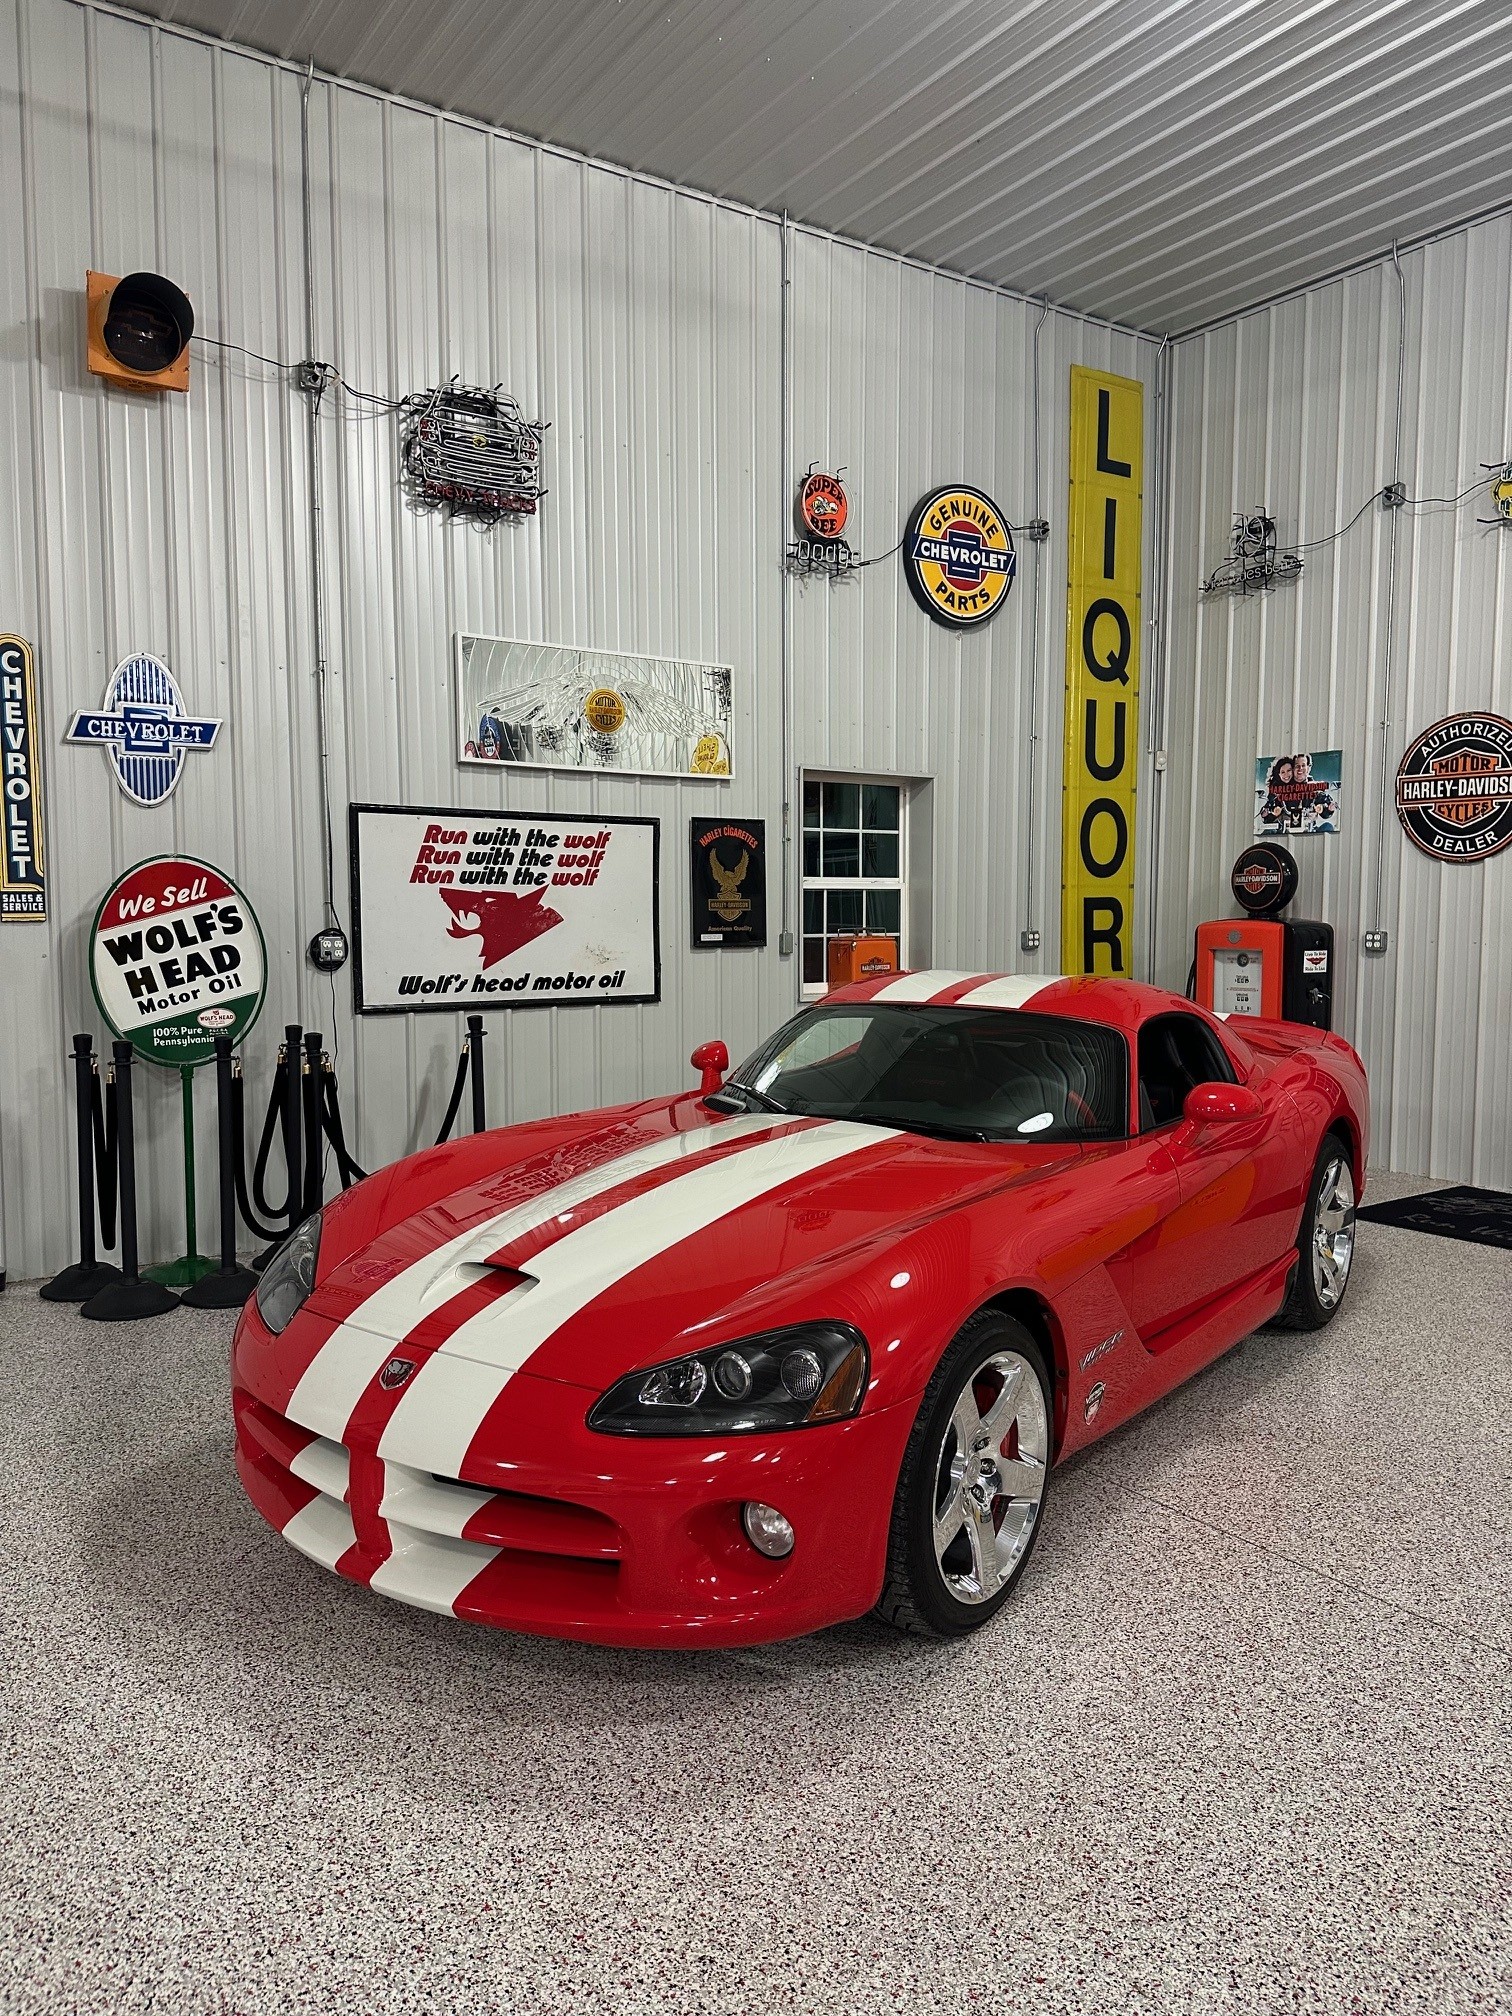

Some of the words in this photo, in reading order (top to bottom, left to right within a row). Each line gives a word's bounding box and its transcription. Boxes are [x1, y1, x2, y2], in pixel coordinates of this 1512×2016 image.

[805, 478, 844, 506] SUPER
[810, 514, 838, 533] BEE
[929, 499, 999, 539] GENUINE
[798, 540, 860, 569] Dodge
[920, 541, 1008, 570] CHEVROLET
[935, 581, 991, 611] PARTS
[1079, 389, 1132, 975] LIQUOR
[87, 719, 204, 742] CHEVROLET
[2, 650, 31, 878] CHEVROLET
[1437, 753, 1492, 774] MOTOR
[1268, 782, 1329, 794] HARLEY-DAVIDSON
[1403, 775, 1512, 800] HARLEY-DAVIDS
[1437, 800, 1490, 822] CYCLES
[423, 824, 468, 845] Run
[472, 826, 521, 847] with
[525, 828, 560, 848] the
[563, 831, 612, 849] wolf
[699, 827, 722, 847] HARLEY
[723, 825, 758, 849] CIGARETTES
[1432, 830, 1499, 853] DEALER
[416, 845, 462, 865] Run
[465, 846, 515, 866] with
[518, 848, 554, 867] the
[557, 851, 606, 868] wolf
[409, 865, 455, 884] Run
[458, 866, 509, 885] with
[512, 867, 548, 886] the
[551, 869, 599, 886] wolf
[2, 902, 44, 911] SERVICE
[36, 894, 43, 902] &
[119, 895, 156, 920] We
[160, 876, 208, 908] Sell
[102, 903, 243, 966] WOLF'S
[124, 944, 241, 999] HEAD
[399, 974, 468, 995] Wolf's
[471, 974, 530, 993] head
[532, 972, 595, 991] motor
[598, 970, 626, 988] oil
[137, 988, 201, 1015] Motor
[208, 973, 242, 994] Oil
[153, 1027, 180, 1038] 100%
[180, 1026, 203, 1036] Pure
[153, 1035, 215, 1047] Pennsylvania
